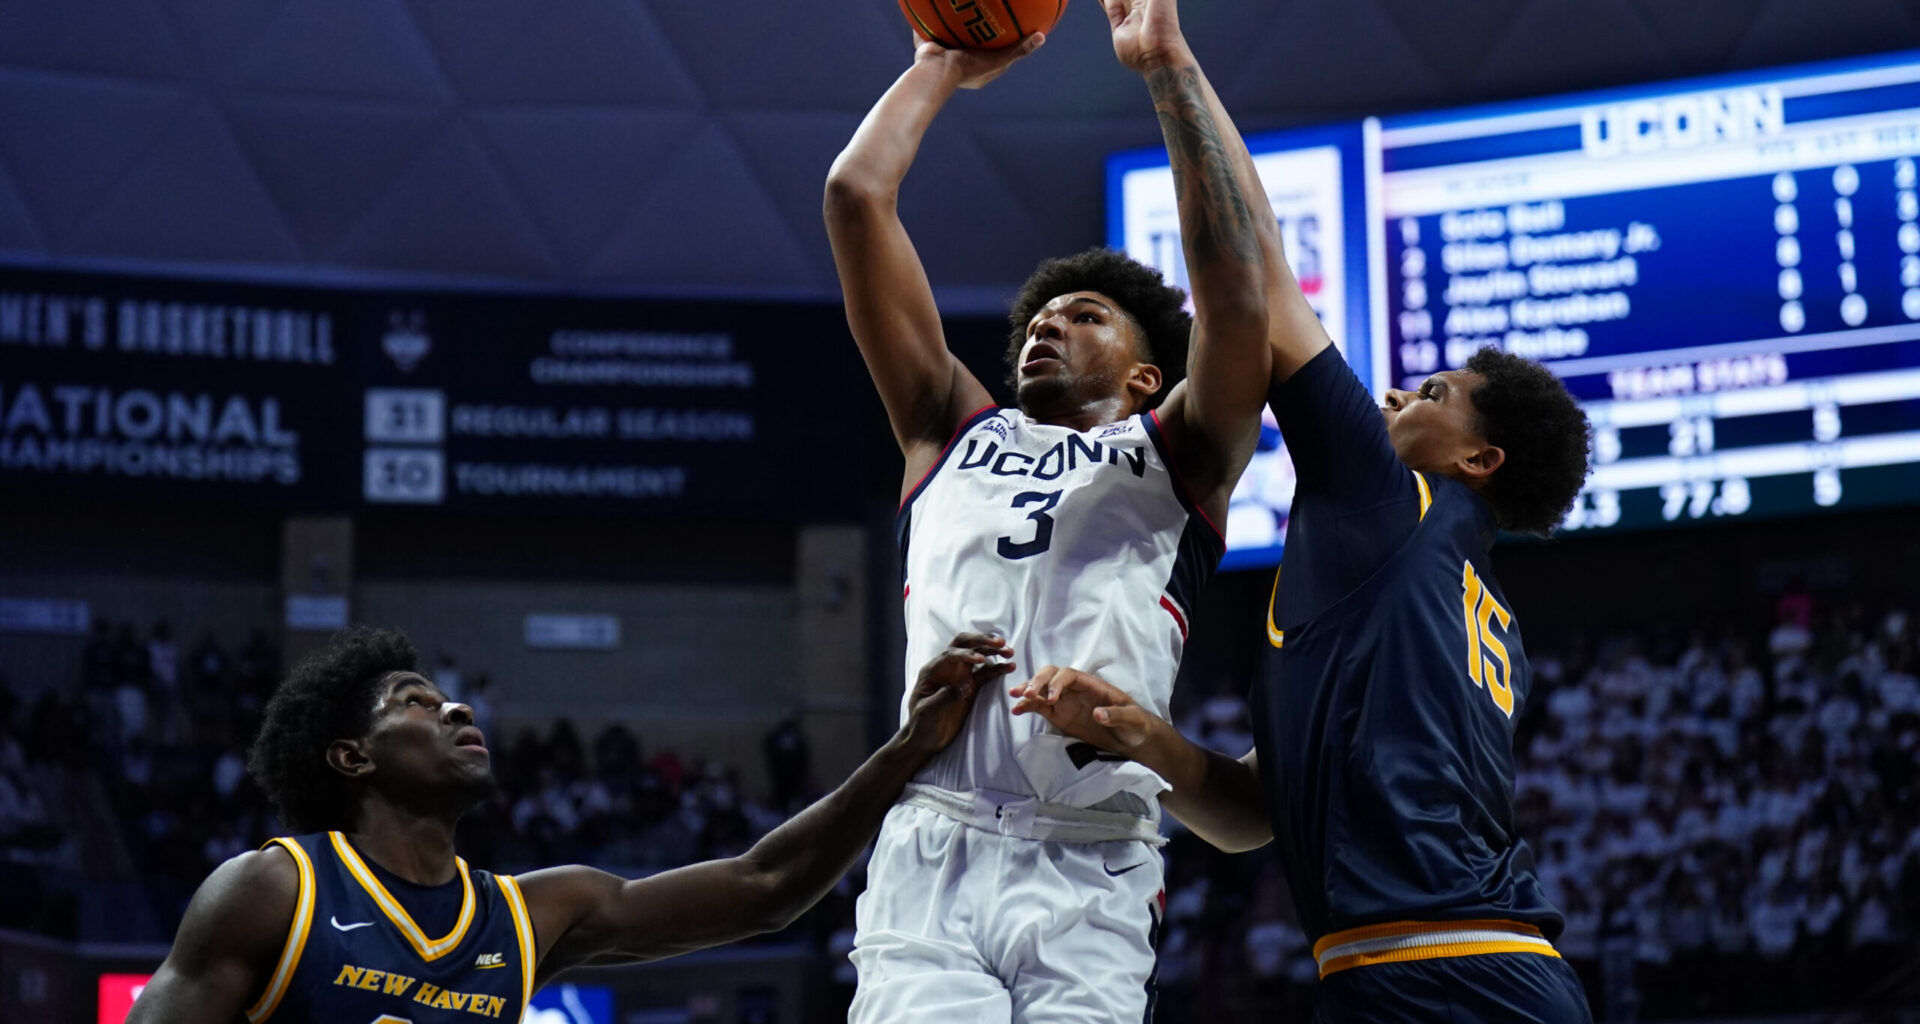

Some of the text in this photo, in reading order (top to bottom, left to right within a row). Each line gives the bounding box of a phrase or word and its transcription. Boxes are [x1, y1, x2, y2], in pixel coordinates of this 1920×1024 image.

[1581, 86, 1785, 158] UCONN
[117, 299, 335, 366] BASKETBALL
[0, 380, 298, 449] ATIONAL
[451, 403, 612, 438] REGULAR
[455, 462, 686, 496] TOURNAMENT
[957, 432, 1146, 480] UCONN
[997, 488, 1064, 560] 3
[1462, 558, 1515, 720] 15
[475, 952, 503, 966] NEC
[333, 963, 508, 1019] NEW HAVEN
